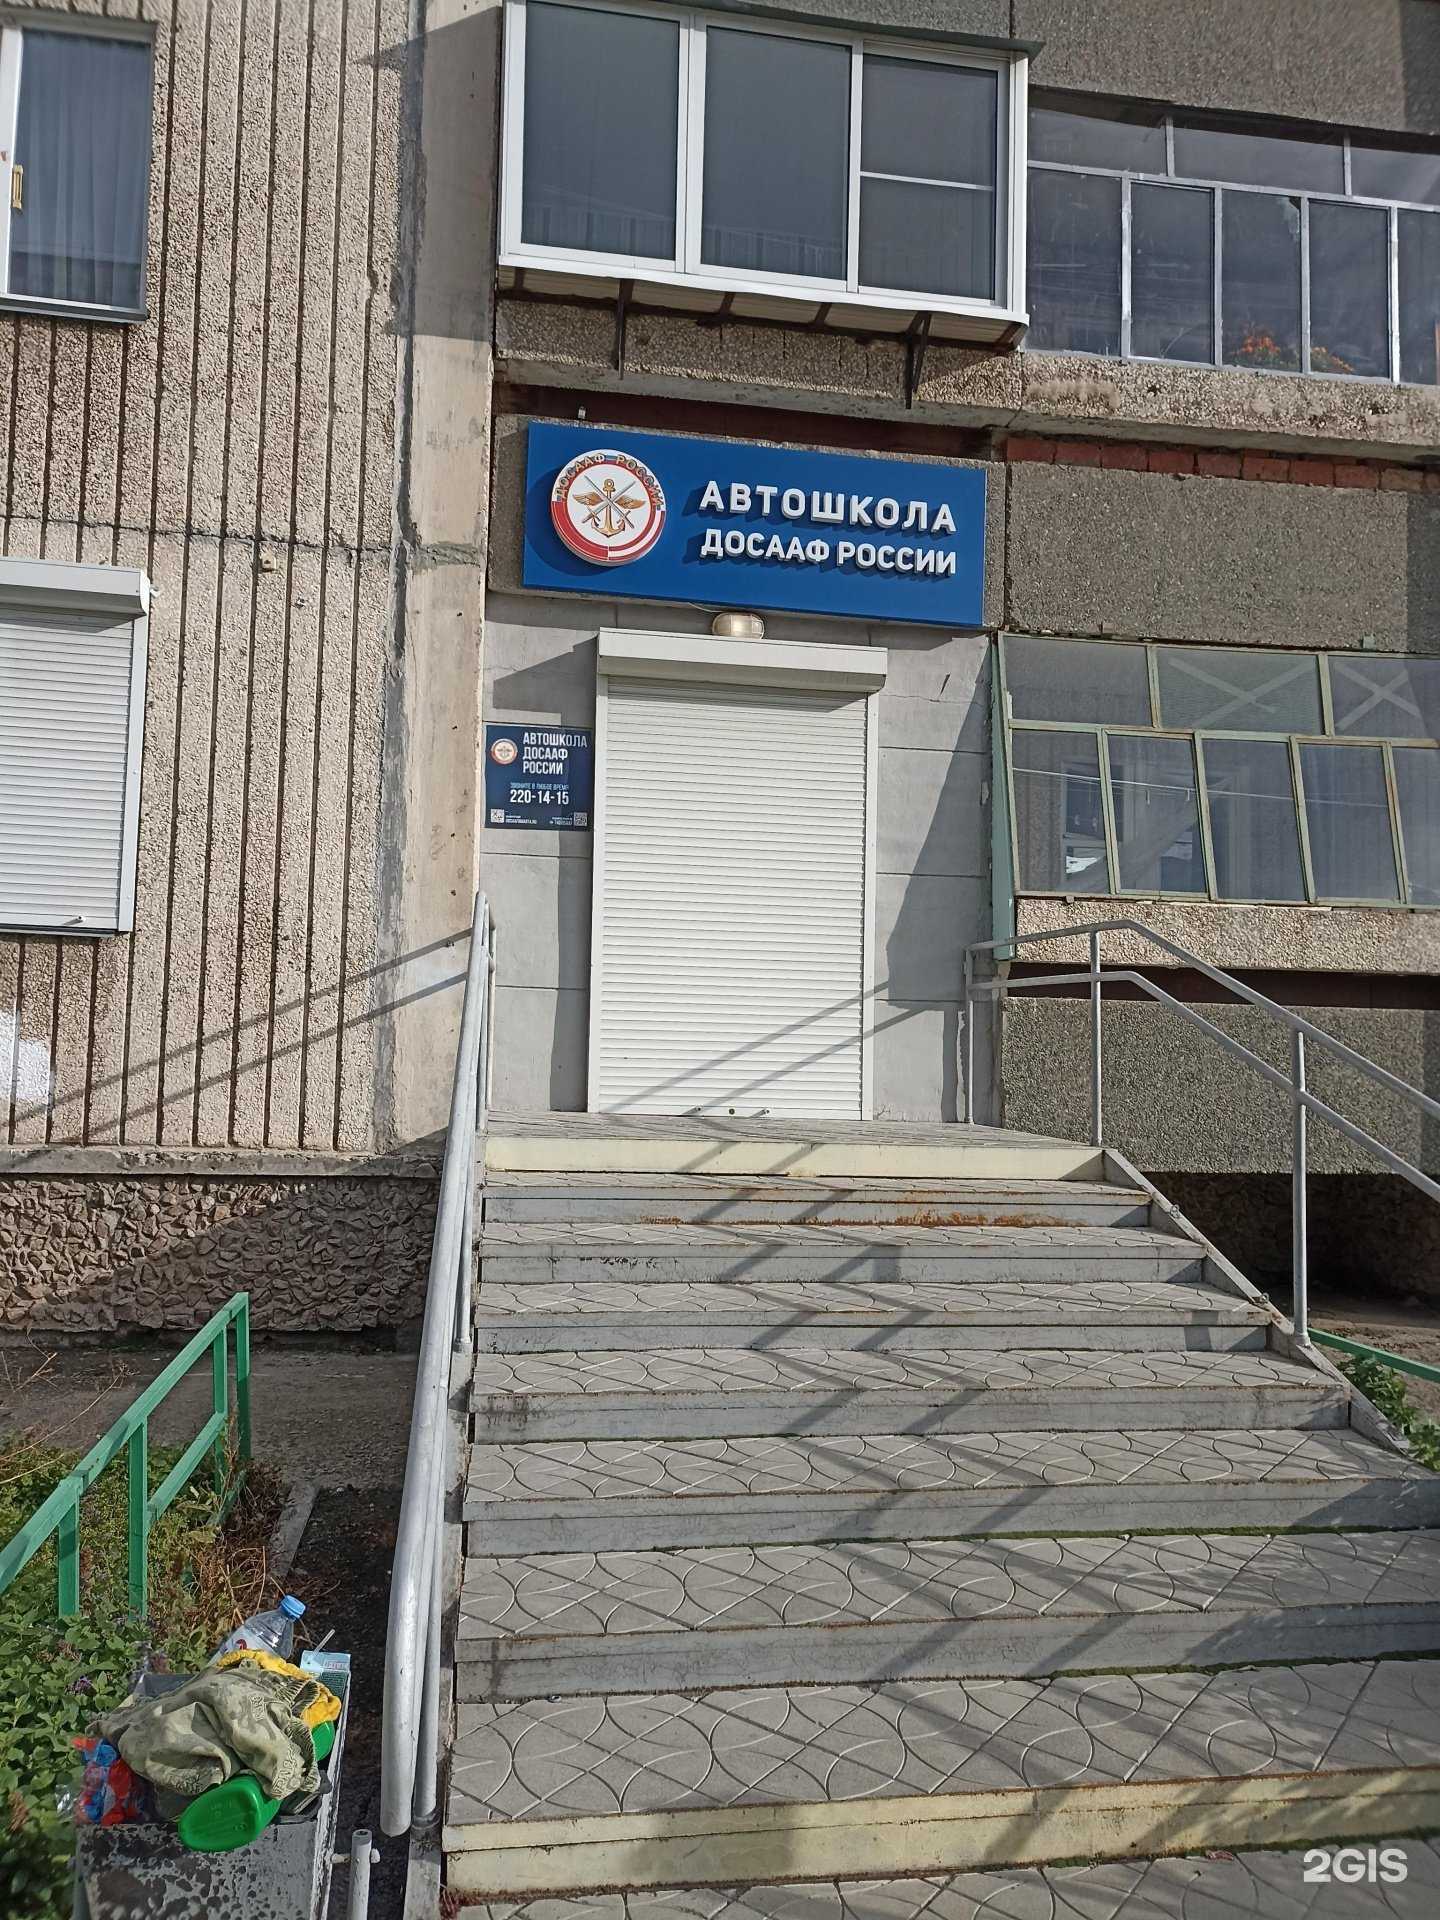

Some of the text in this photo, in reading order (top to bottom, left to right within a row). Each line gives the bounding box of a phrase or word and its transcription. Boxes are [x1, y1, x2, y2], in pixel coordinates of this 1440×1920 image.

[553, 453, 665, 510] ДОСААФ РОССИИ
[699, 480, 957, 535] АВТОШКОЛА
[700, 528, 956, 576] ДОСААФ РОССИИ
[523, 732, 588, 748] АВТОШКОЛА
[522, 747, 568, 760] ДОСААФ
[523, 761, 563, 775] РОССИИ
[510, 790, 569, 805] 220-14-15
